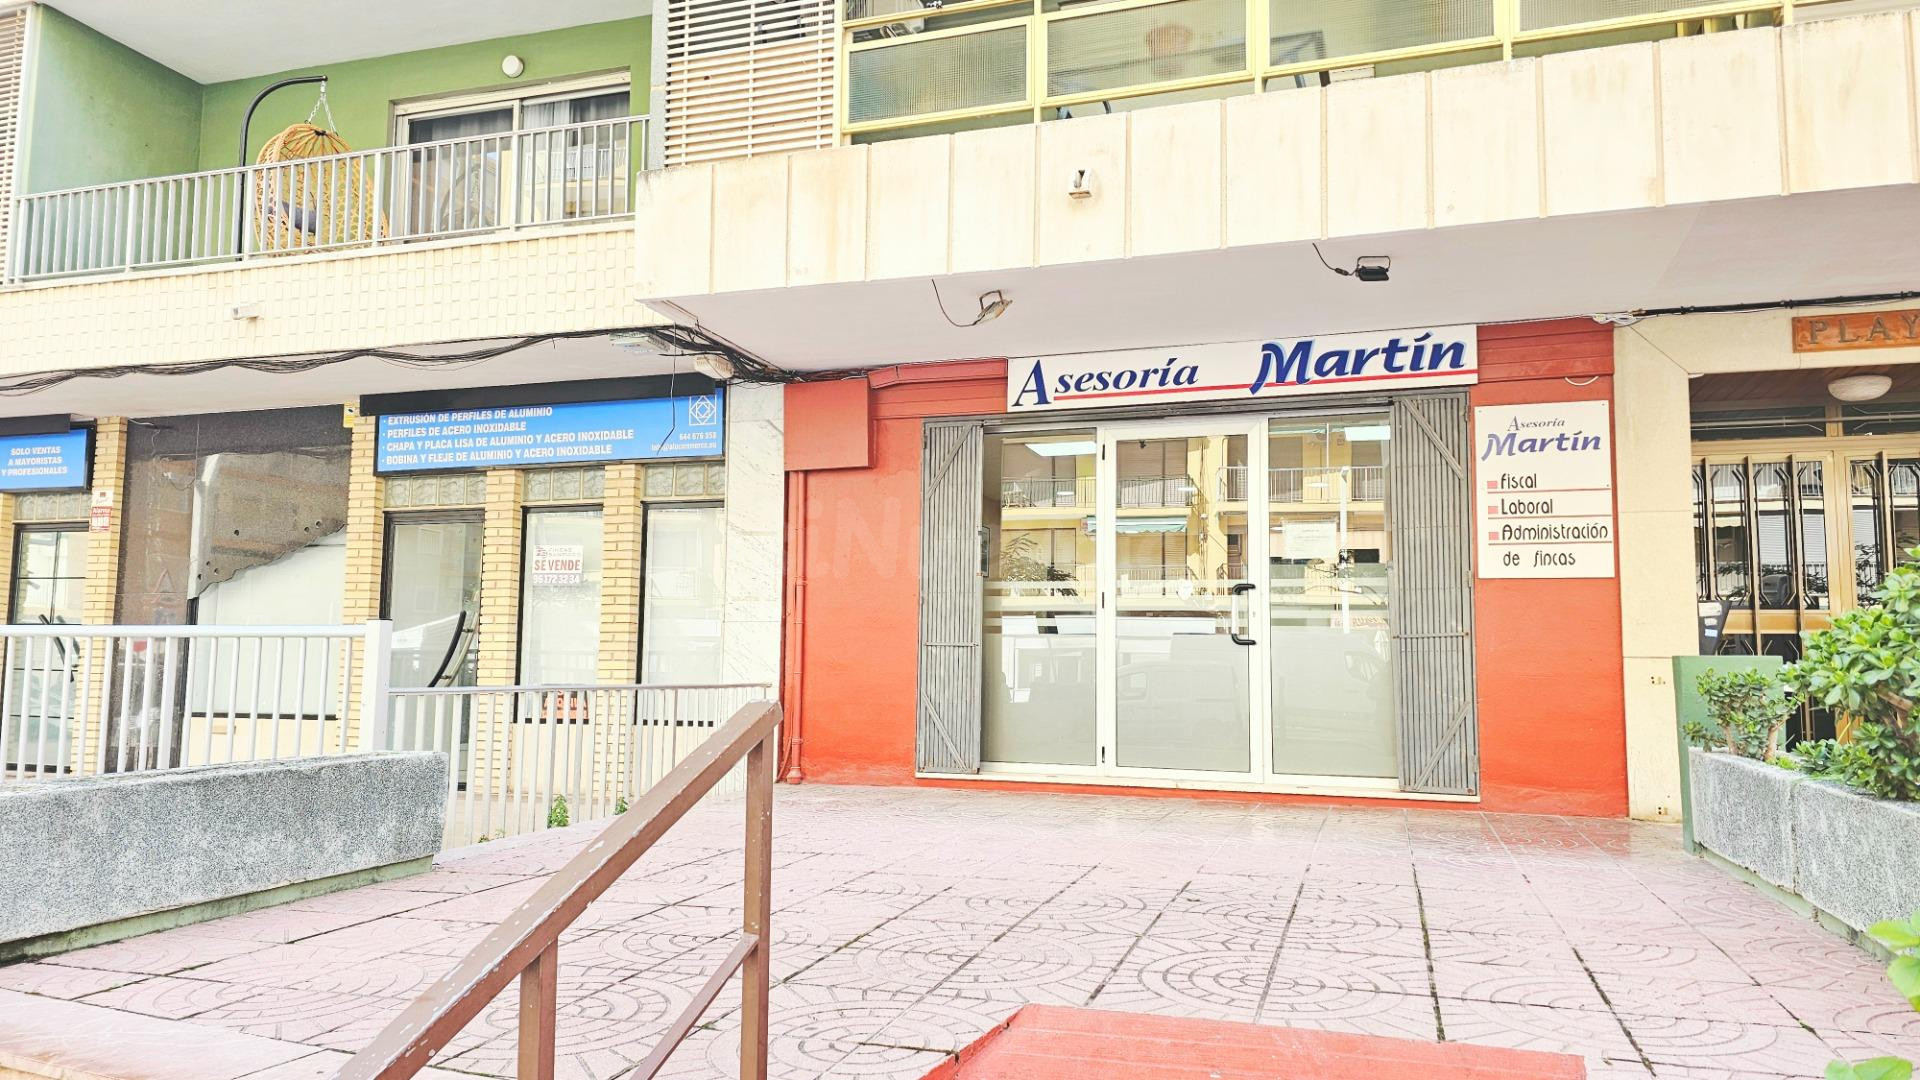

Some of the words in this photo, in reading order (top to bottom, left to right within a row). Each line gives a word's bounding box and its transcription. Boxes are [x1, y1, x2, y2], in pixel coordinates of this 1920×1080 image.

[1808, 314, 1920, 345] PLAY
[1012, 357, 1199, 407] Asesoría
[1248, 331, 1467, 396] Martín
[388, 412, 436, 426] EXTRUSIÓN
[438, 413, 450, 422] DE
[452, 410, 493, 422] PERFILES
[494, 409, 506, 420] DE
[508, 406, 553, 418] ALUMINIO
[1507, 415, 1566, 432] Asesoría
[387, 427, 427, 438] PERFILES
[428, 426, 440, 436] DE
[442, 424, 472, 435] ACERO
[473, 421, 527, 434] INOXIDABLE
[386, 440, 416, 452] CHAPA
[416, 440, 424, 450] Y
[424, 438, 453, 450] PLACA
[454, 438, 474, 448] LISA
[475, 436, 488, 446] DE
[488, 434, 534, 446] ALUMINIO
[536, 434, 544, 444] Y
[544, 432, 576, 443] ACERO
[578, 428, 635, 442] INOXIDABLE
[1481, 430, 1601, 462] Martín
[10, 448, 31, 456] SOLO
[32, 446, 62, 455] VENTAS
[386, 452, 418, 465] BOBINA
[419, 453, 428, 464] Y
[428, 452, 454, 463] FLEJE
[456, 451, 469, 462] DE
[470, 448, 513, 460] ALUMINIO
[515, 448, 524, 458] Y
[524, 447, 555, 458] ACERO
[556, 444, 613, 456] INOXIDABLE
[8, 458, 14, 466] A
[14, 456, 62, 466] MAYORISTAS
[7, 466, 68, 477] PROFESIONALES
[1501, 498, 1554, 515] Laboral
[1502, 522, 1609, 541] Administración
[534, 560, 546, 571] SE
[548, 559, 581, 571] VENDE
[1503, 550, 1521, 567] de
[1533, 549, 1576, 568] fincas
